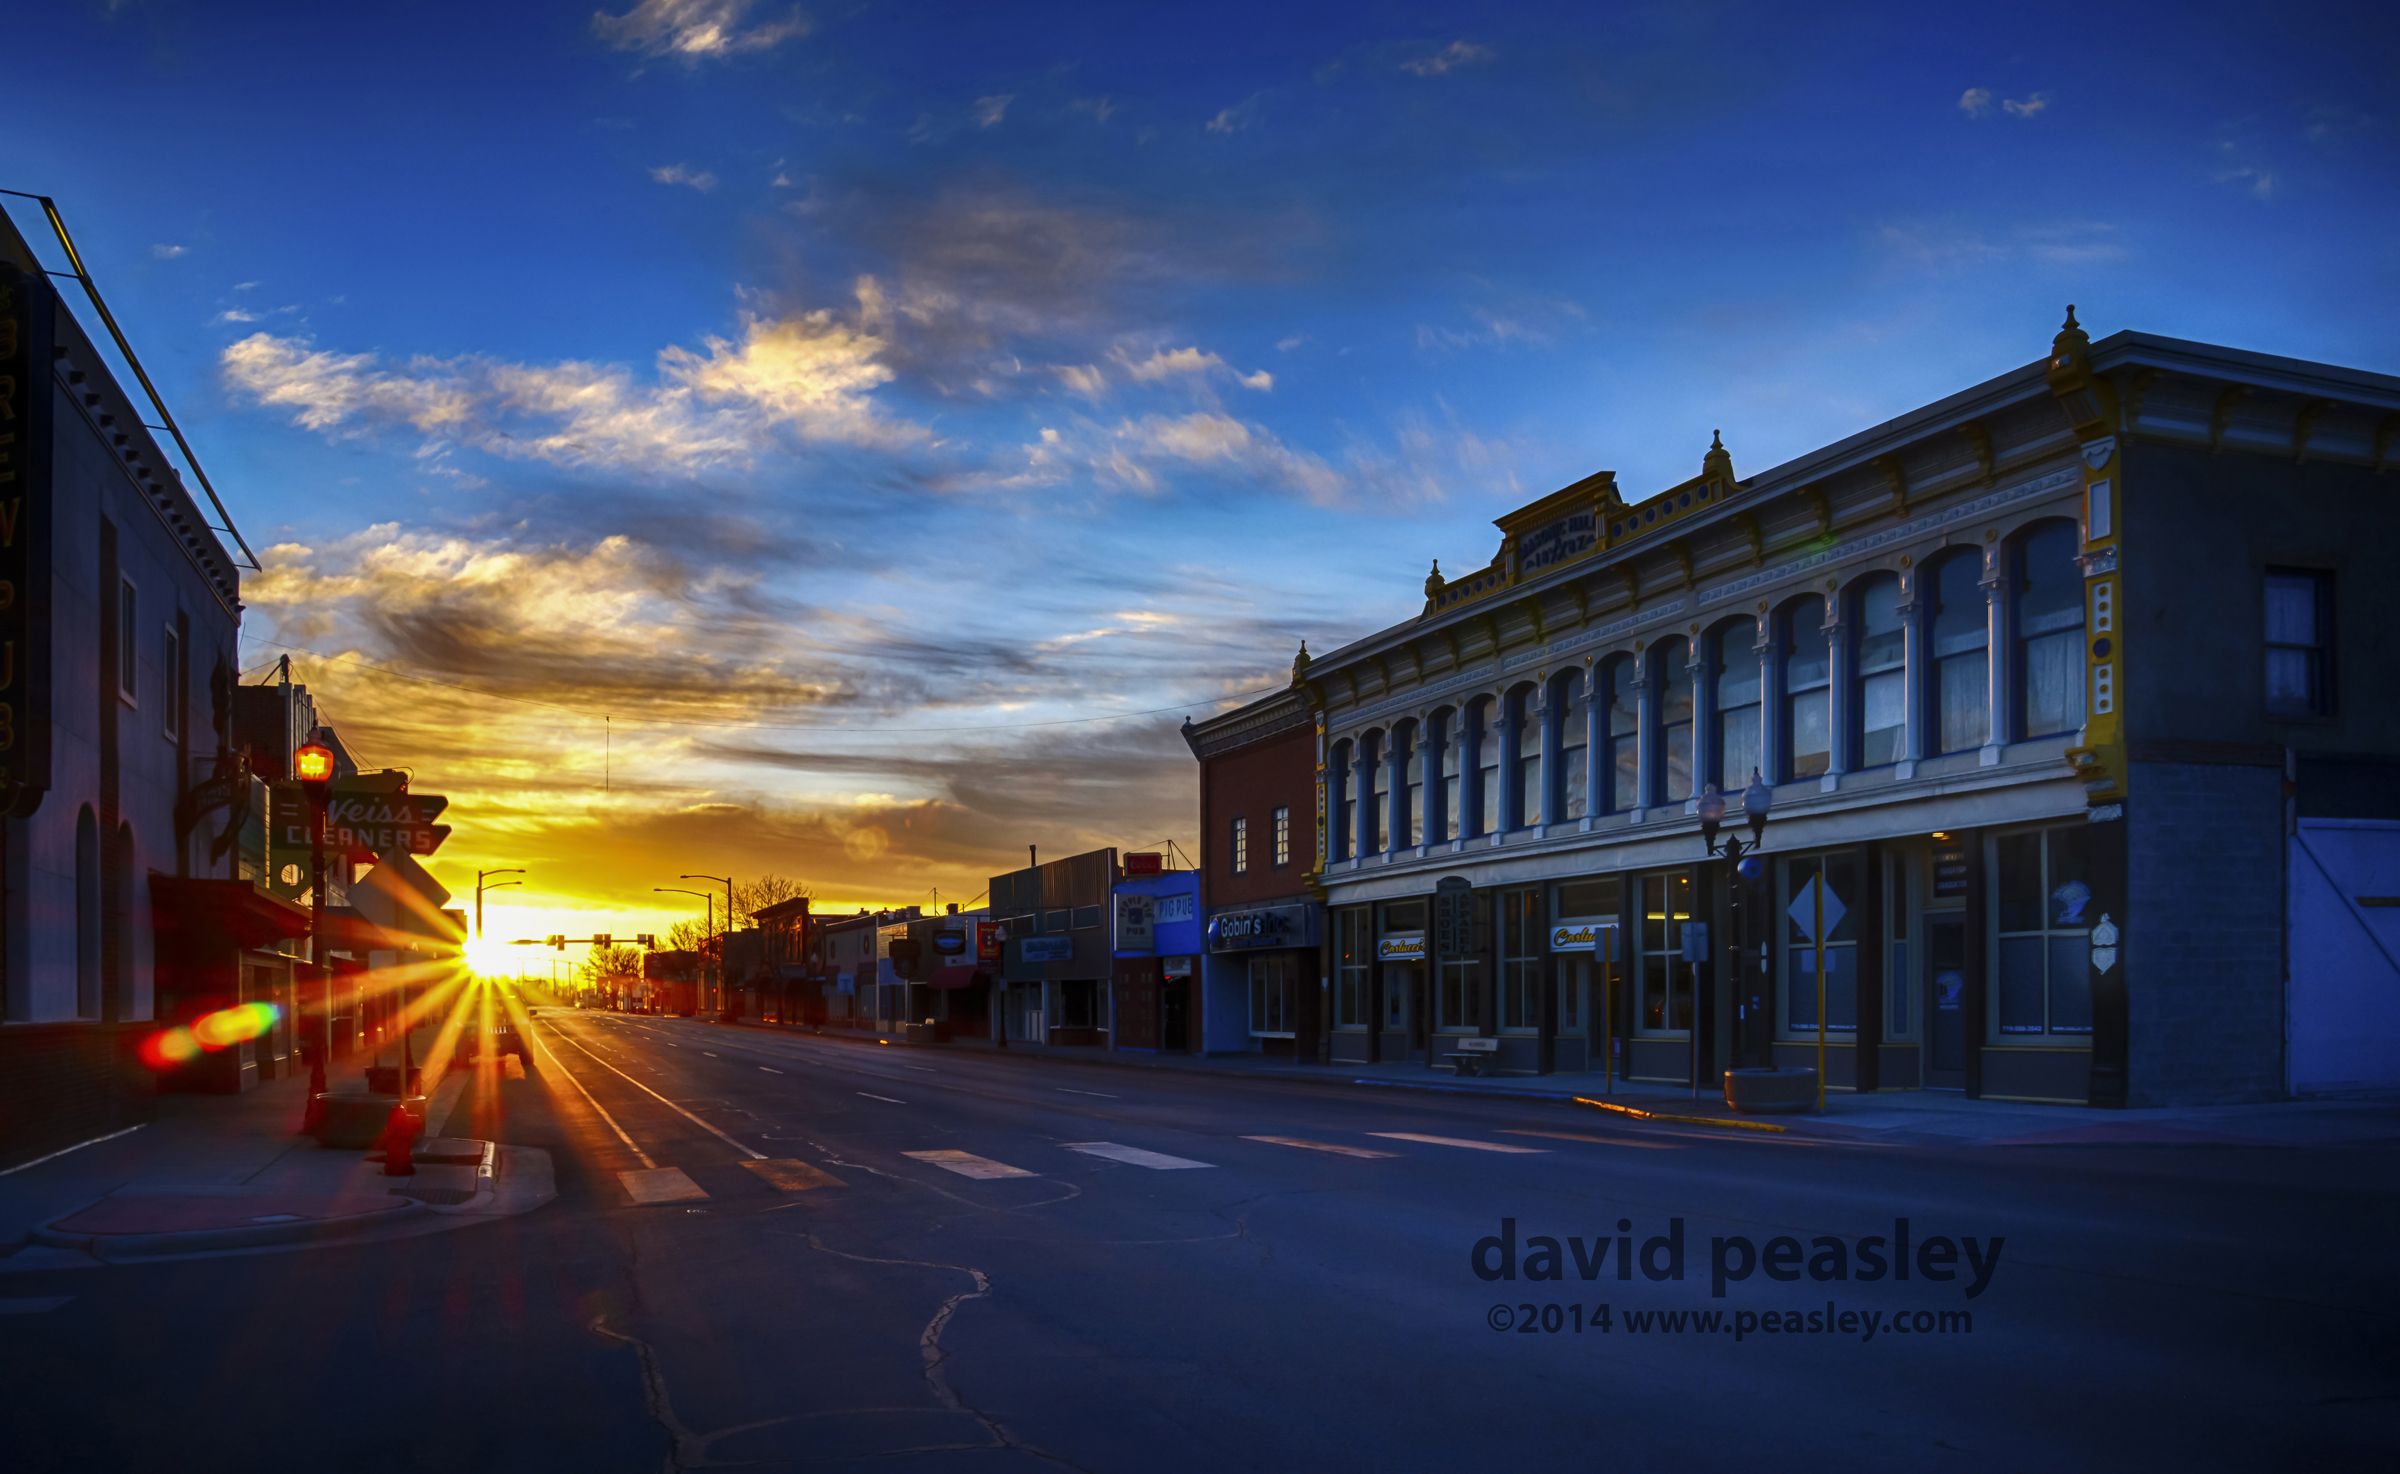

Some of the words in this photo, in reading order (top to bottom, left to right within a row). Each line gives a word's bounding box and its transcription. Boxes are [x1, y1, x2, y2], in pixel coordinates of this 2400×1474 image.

[287, 825, 431, 850] CLEANERS
[1159, 899, 1174, 917] PIG
[1176, 897, 1193, 916] PUB
[1126, 927, 1145, 935] PUB
[1220, 915, 1262, 938] Gobin's
[1440, 897, 1450, 952] SHOES
[1459, 892, 1470, 954] APPAREL
